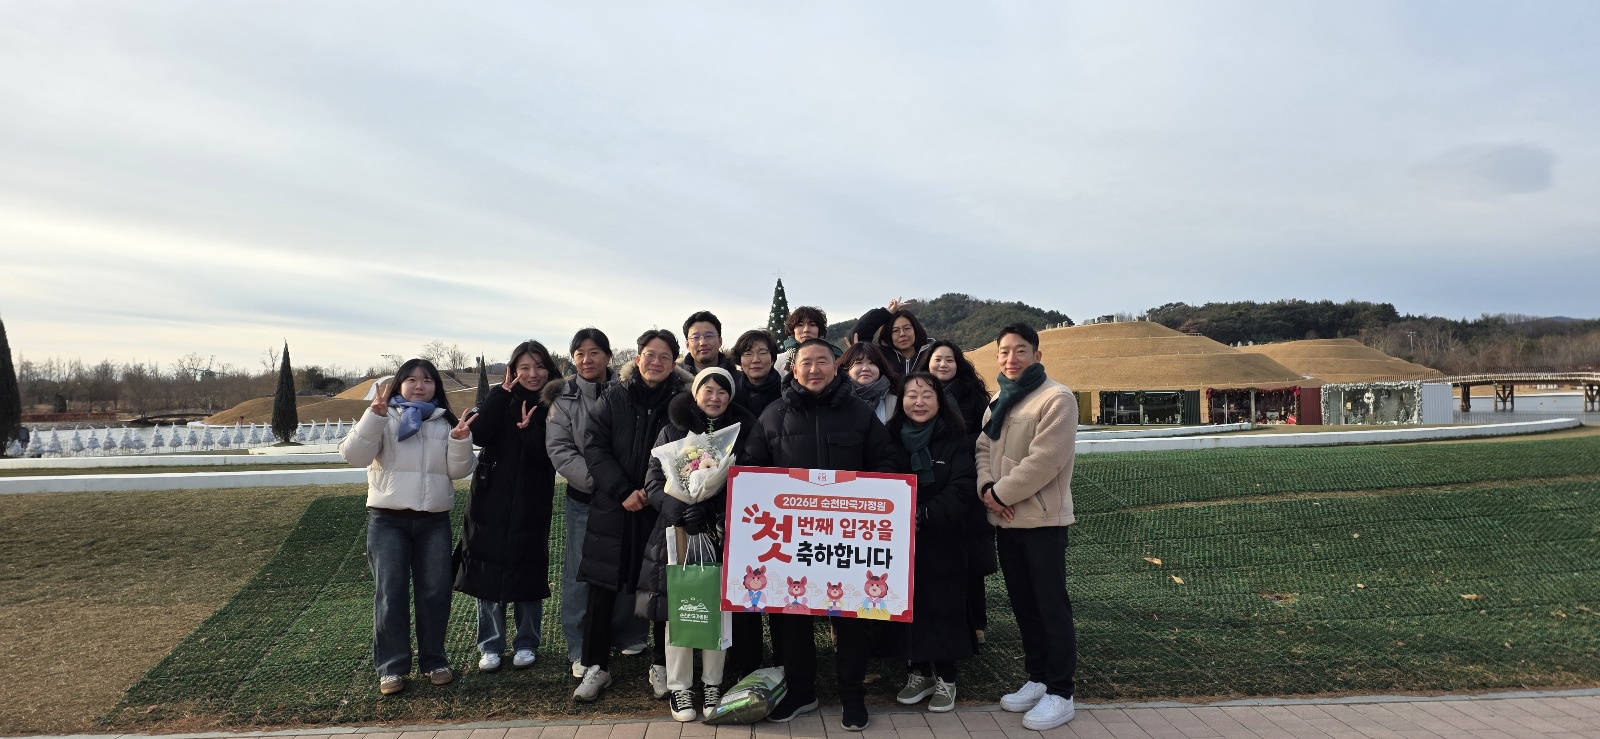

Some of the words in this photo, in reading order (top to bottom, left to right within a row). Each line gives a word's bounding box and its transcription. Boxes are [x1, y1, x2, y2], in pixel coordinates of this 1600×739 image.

[782, 496, 818, 508] 2026년
[820, 497, 887, 511] 순천만국가정원
[751, 511, 793, 564] 첫
[797, 516, 834, 536] 번째
[839, 517, 894, 541] 입장을
[796, 540, 893, 569] 축하합니다
